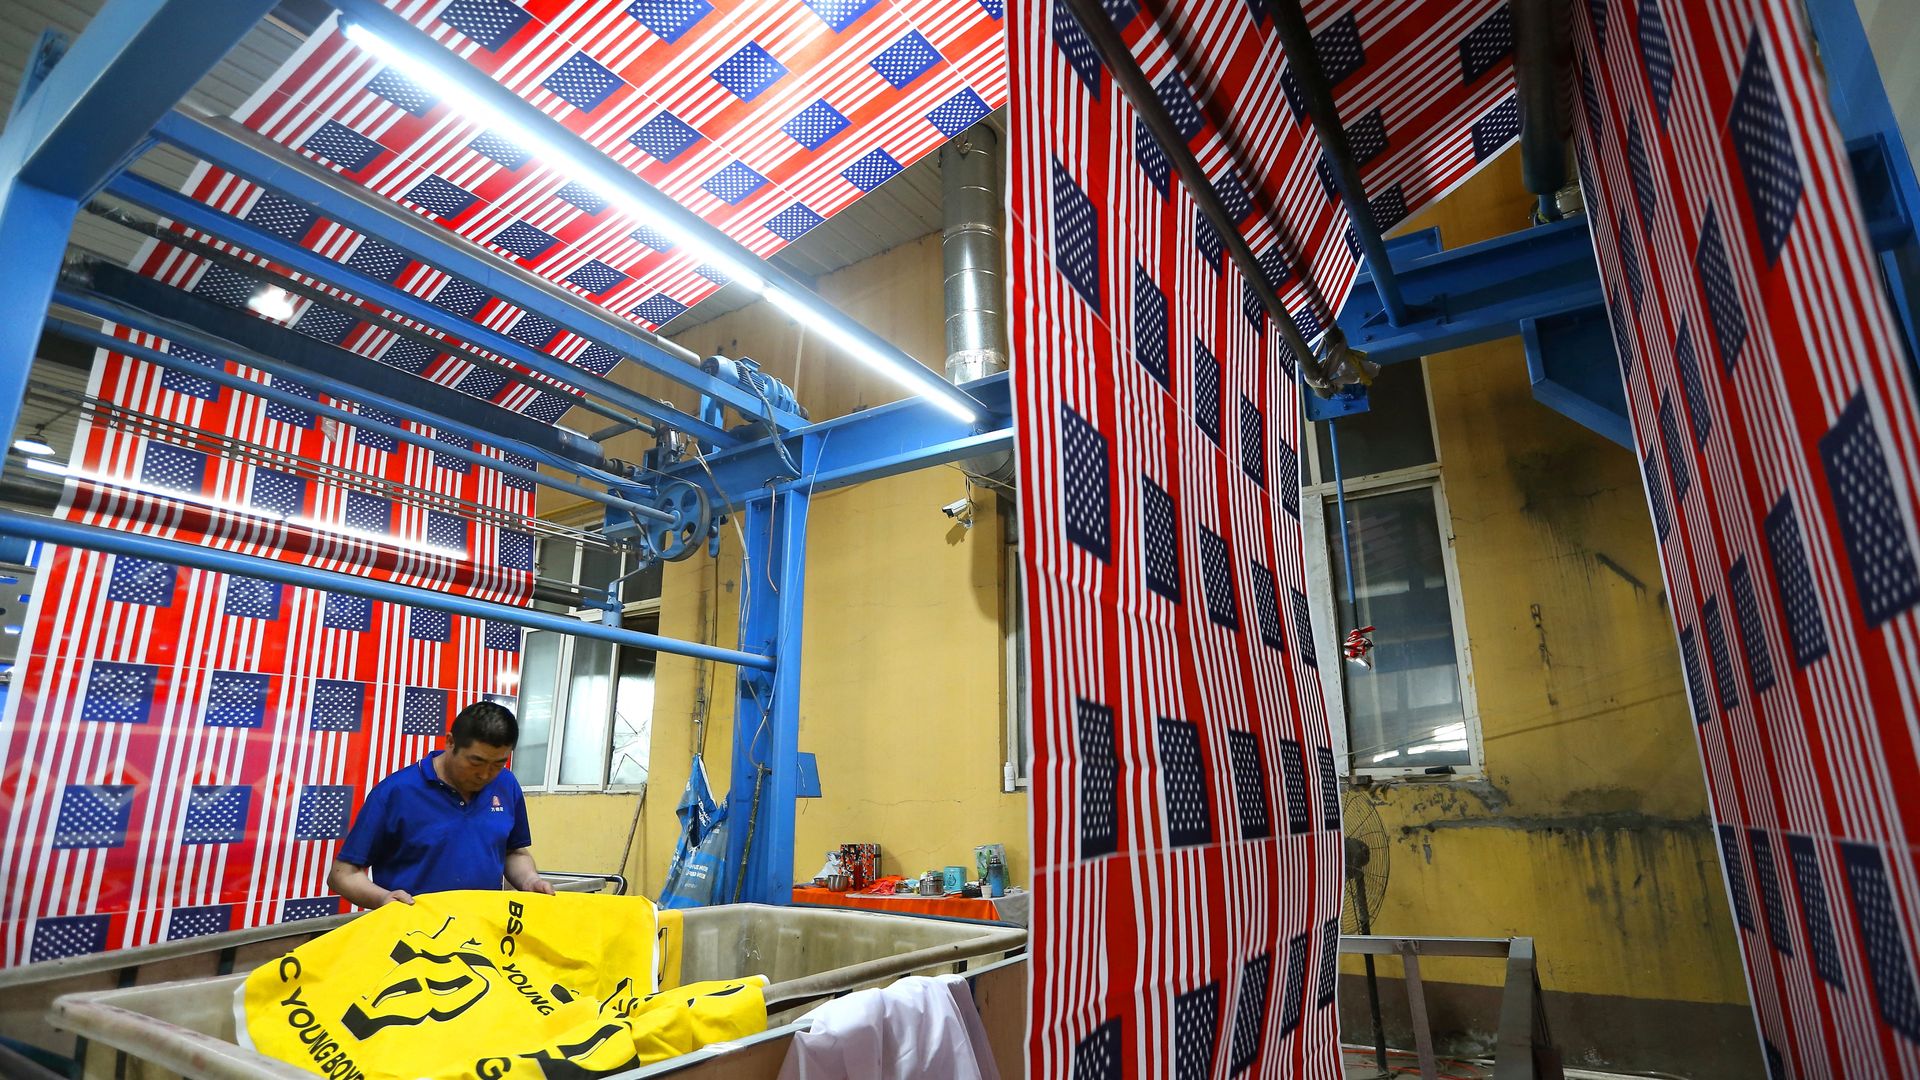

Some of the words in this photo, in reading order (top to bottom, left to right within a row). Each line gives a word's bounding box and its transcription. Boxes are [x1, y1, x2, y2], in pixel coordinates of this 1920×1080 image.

[500, 900, 524, 957] BSC
[279, 950, 302, 983] C
[502, 963, 555, 1016] YOUNG
